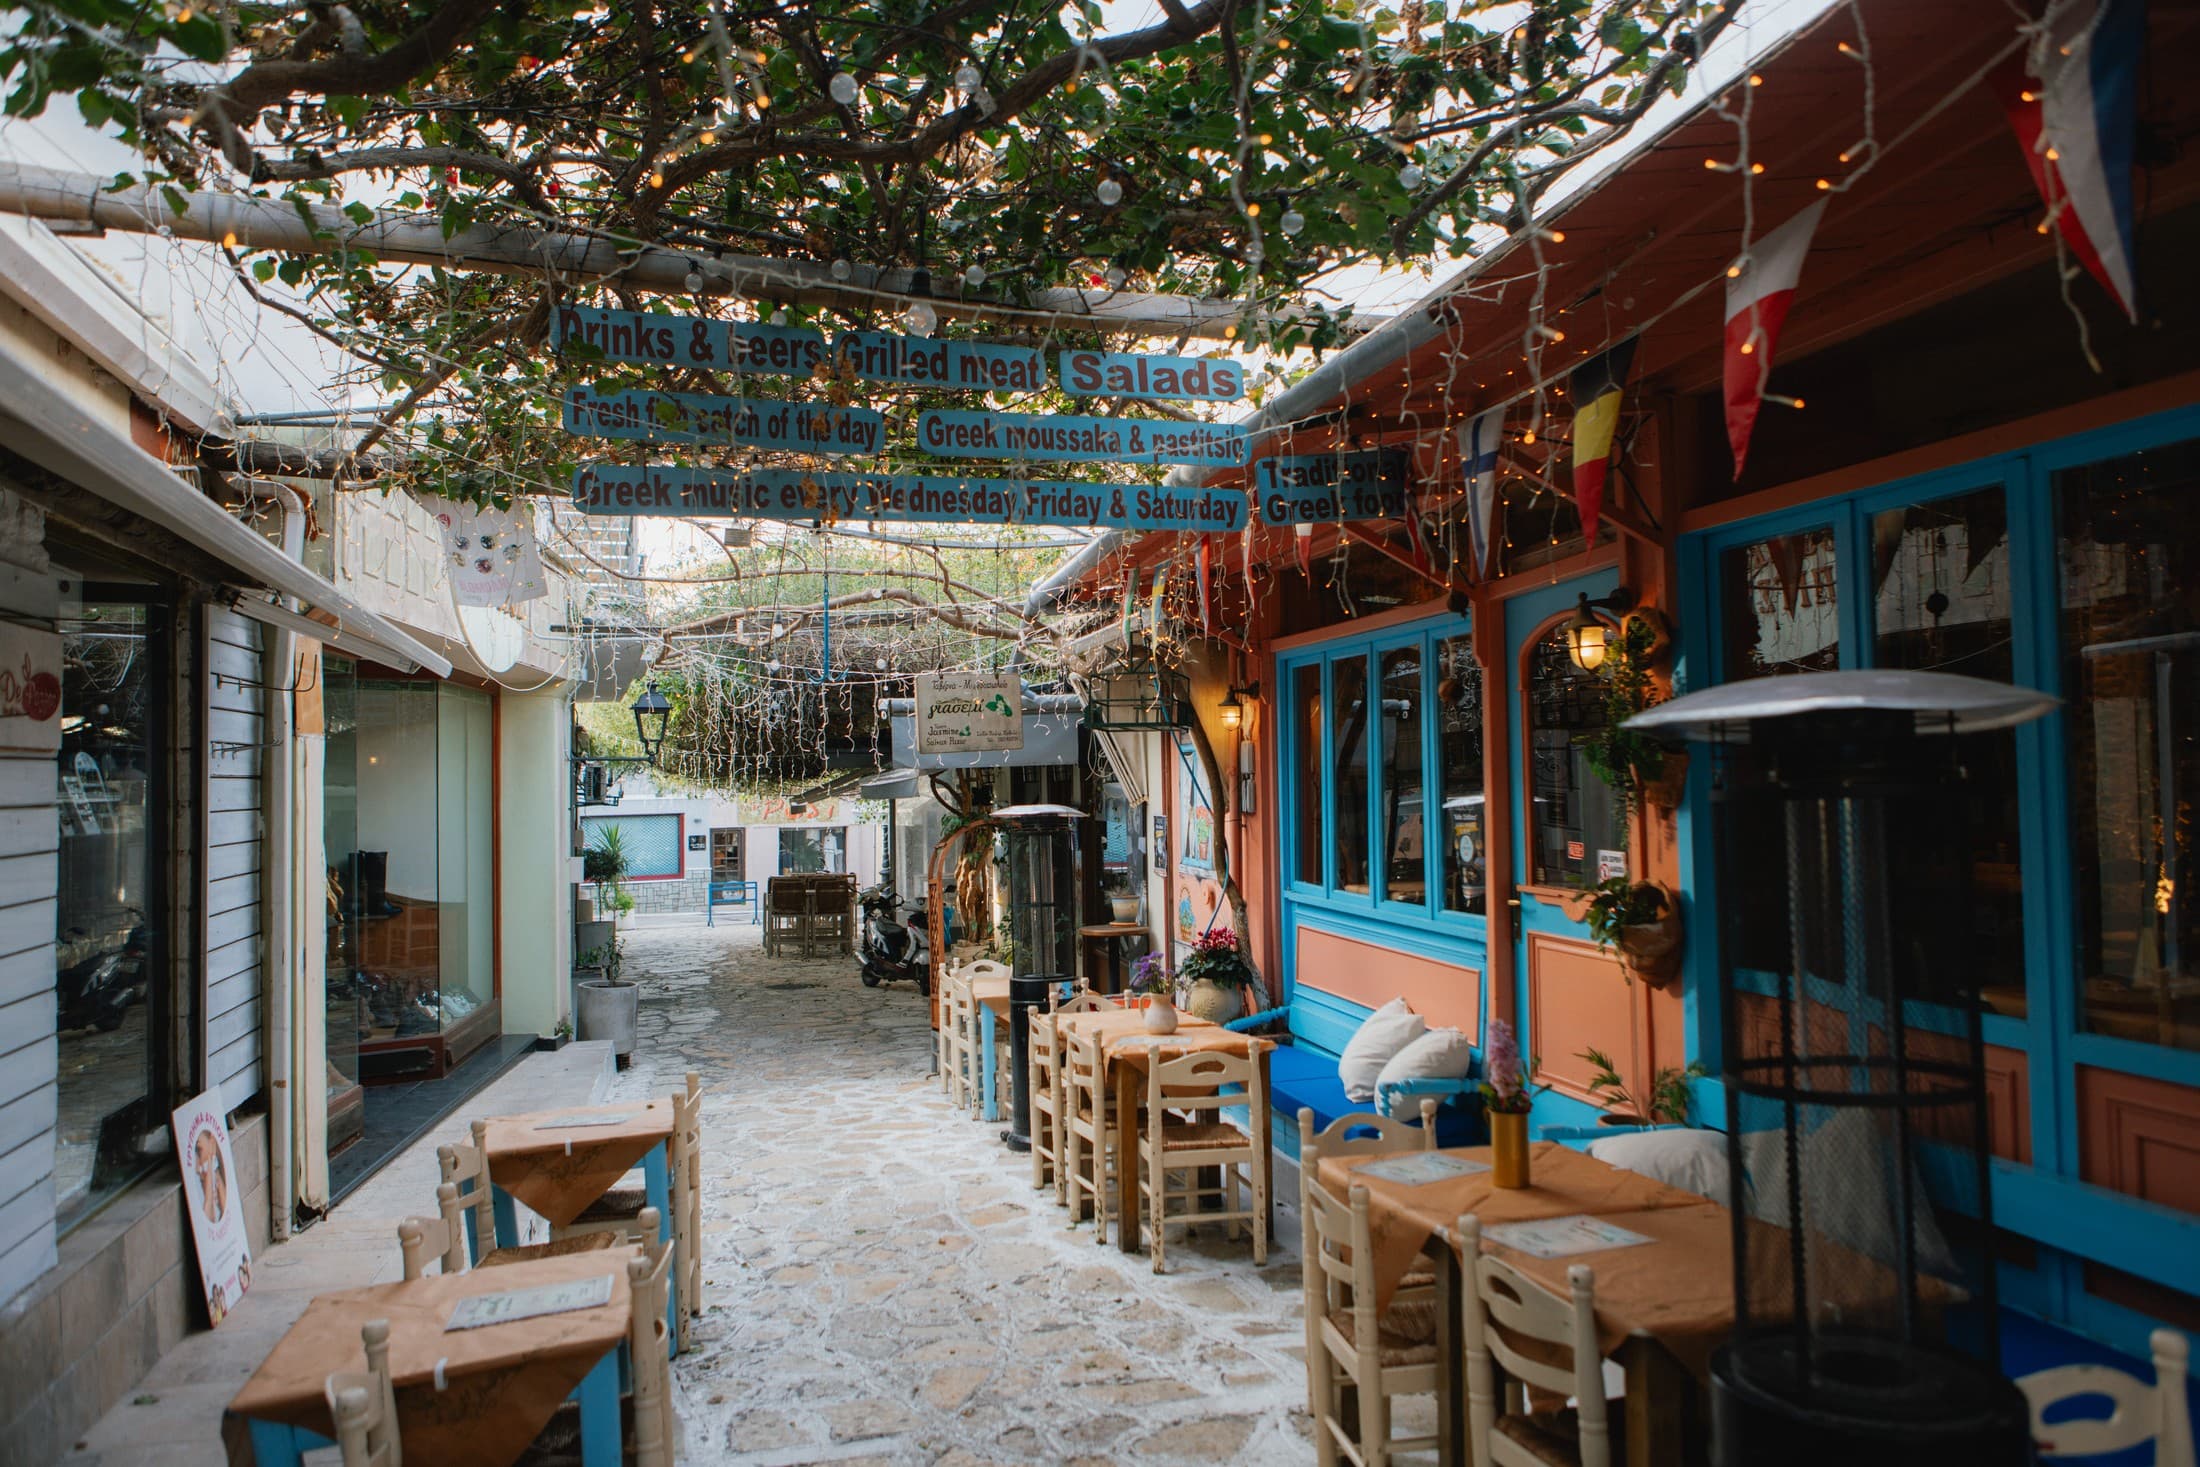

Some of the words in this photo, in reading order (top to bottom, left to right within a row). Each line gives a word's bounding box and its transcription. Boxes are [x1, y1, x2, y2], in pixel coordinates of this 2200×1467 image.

[560, 309, 675, 359] Drinks
[689, 320, 714, 362] &
[839, 334, 948, 381] Grilled
[960, 353, 1040, 389] meat
[1072, 354, 1237, 397] Salads
[573, 391, 639, 428] Fresh
[645, 396, 688, 432] fih
[768, 407, 789, 439] of
[838, 413, 877, 452] day
[926, 415, 999, 448] Greek
[1007, 424, 1121, 453] moussaka
[1129, 425, 1145, 454] &
[1152, 428, 1243, 462] pastitsio
[578, 472, 673, 507] Greek
[683, 477, 770, 509] music
[780, 481, 858, 518] eery
[1026, 487, 1101, 525] Friday
[1110, 489, 1126, 519] &
[1136, 490, 1239, 528] Saturday
[1267, 491, 1348, 524] Greek
